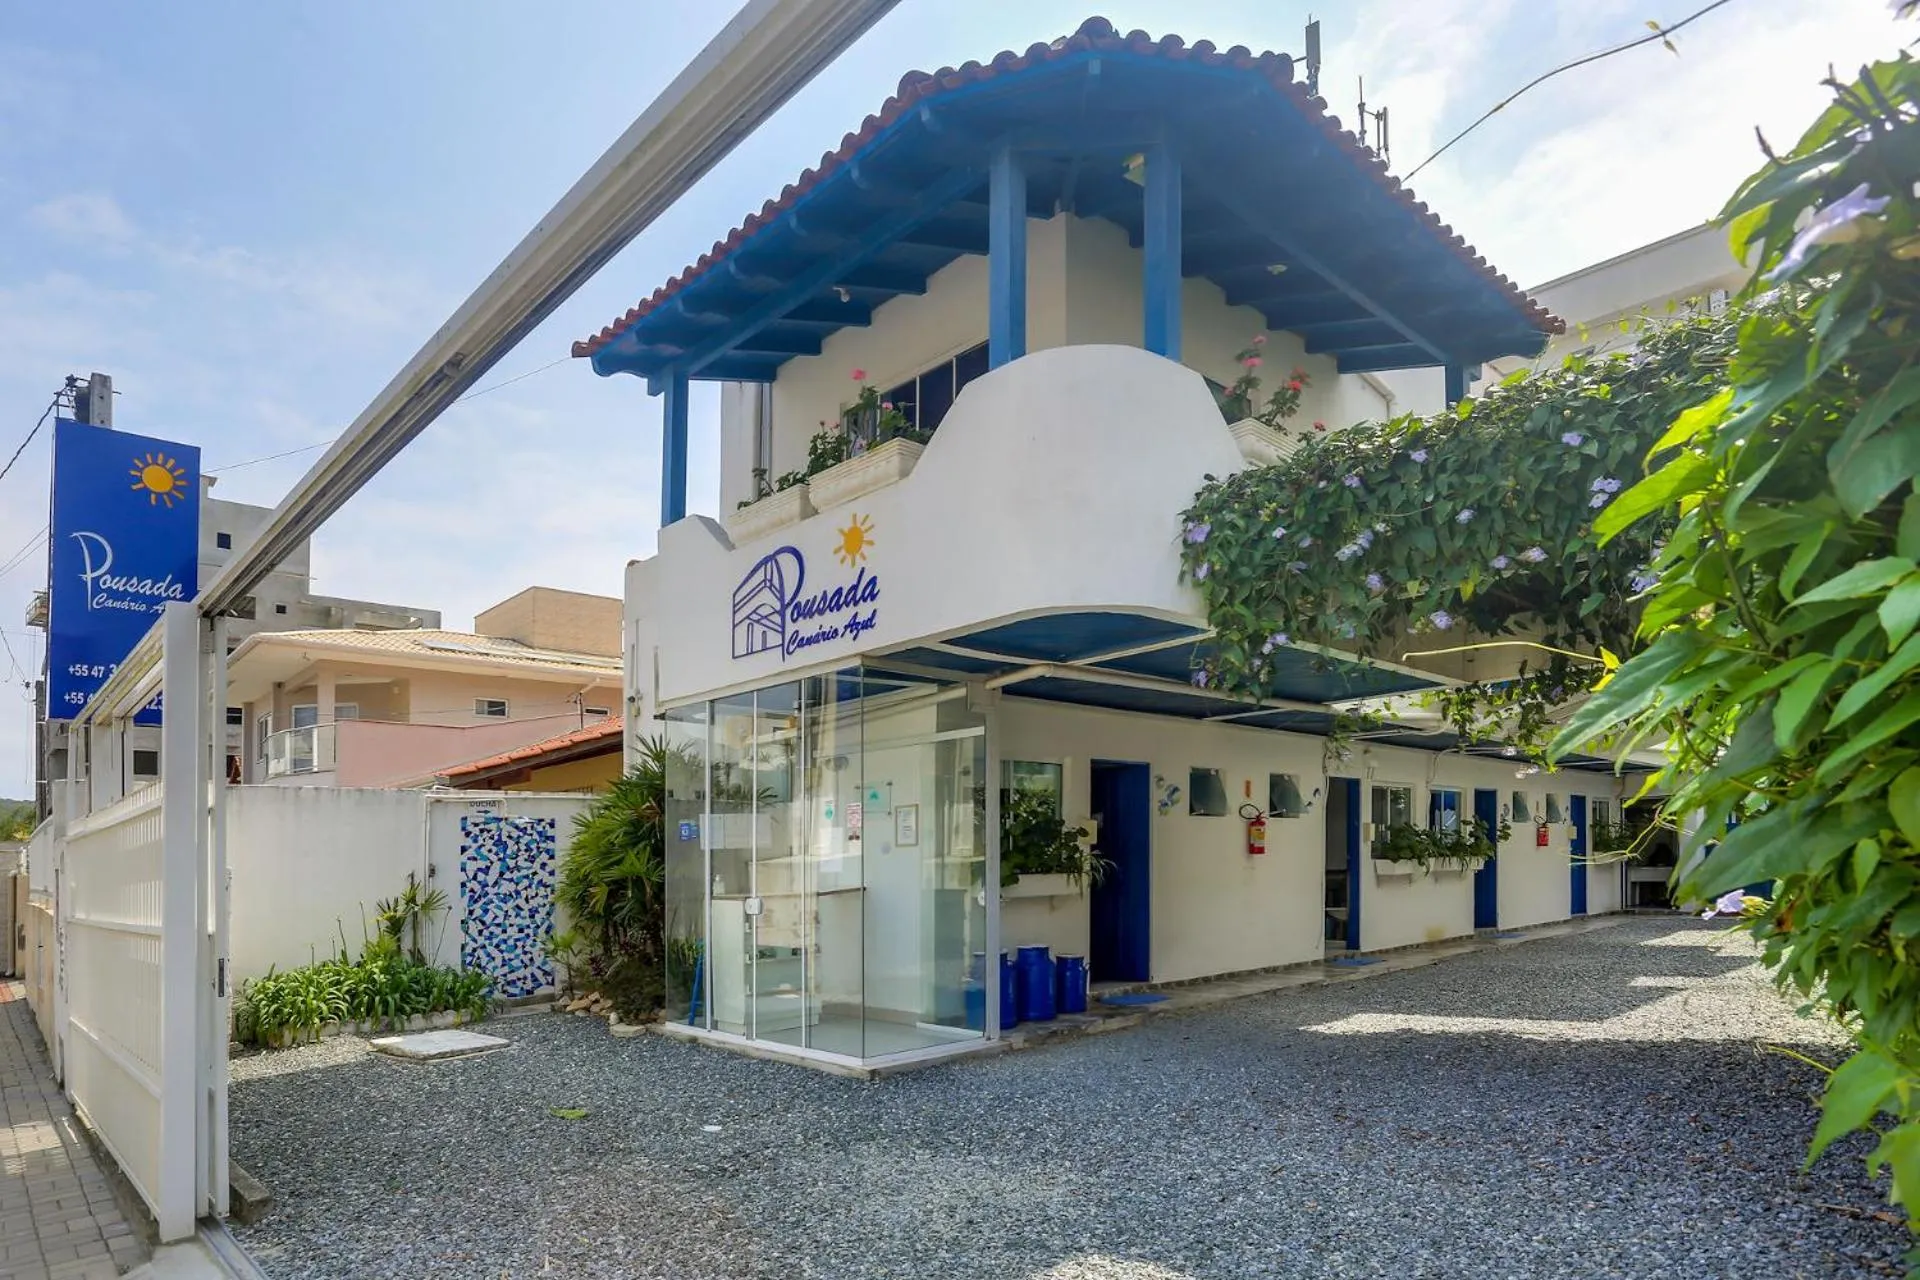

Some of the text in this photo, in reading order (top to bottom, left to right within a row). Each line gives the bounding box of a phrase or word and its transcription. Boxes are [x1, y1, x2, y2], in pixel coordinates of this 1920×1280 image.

[70, 532, 184, 612] Pousada
[93, 593, 147, 612] Canário
[773, 546, 880, 662] Pousada
[786, 609, 877, 655] Canário Azul
[68, 664, 88, 677] +55
[91, 665, 105, 678] 47
[64, 692, 84, 704] +55
